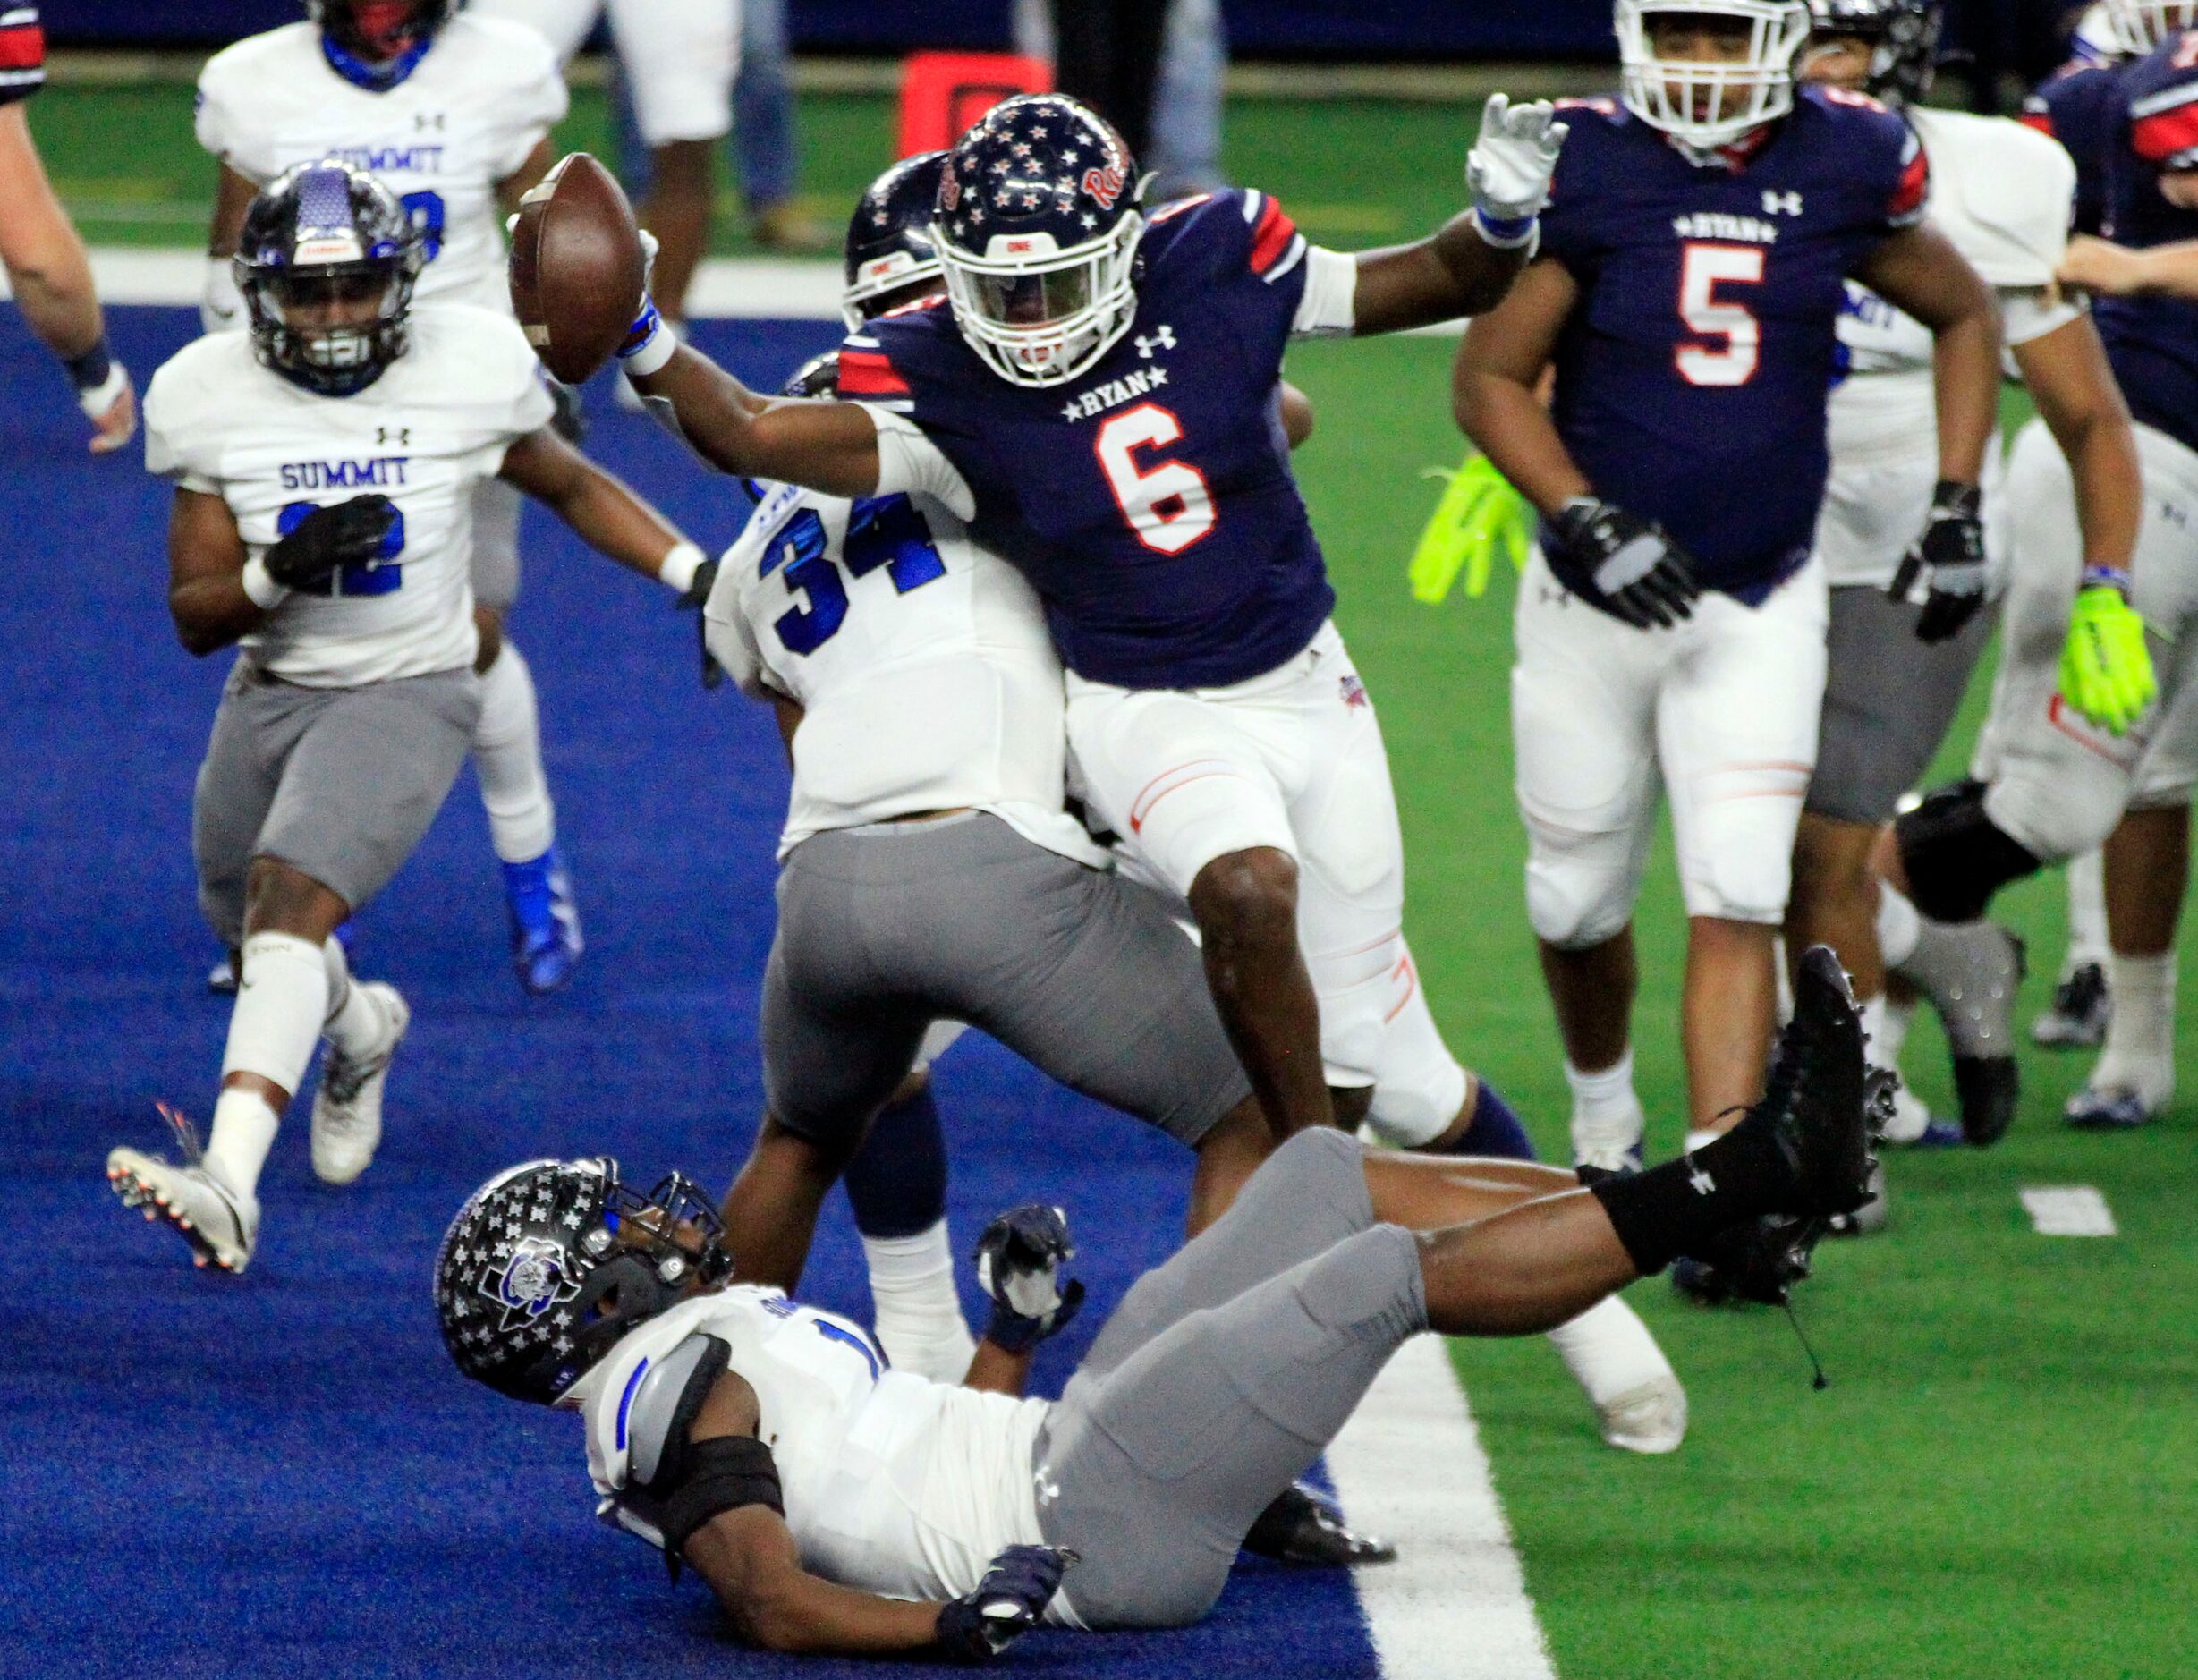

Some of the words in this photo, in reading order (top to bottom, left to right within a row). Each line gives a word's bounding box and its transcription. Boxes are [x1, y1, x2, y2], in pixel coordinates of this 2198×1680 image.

[1674, 241, 1766, 386] 5
[1079, 369, 1150, 416] RYAN
[282, 456, 409, 489] SUMMIT
[1094, 401, 1218, 556] 6
[758, 492, 948, 658] 34
